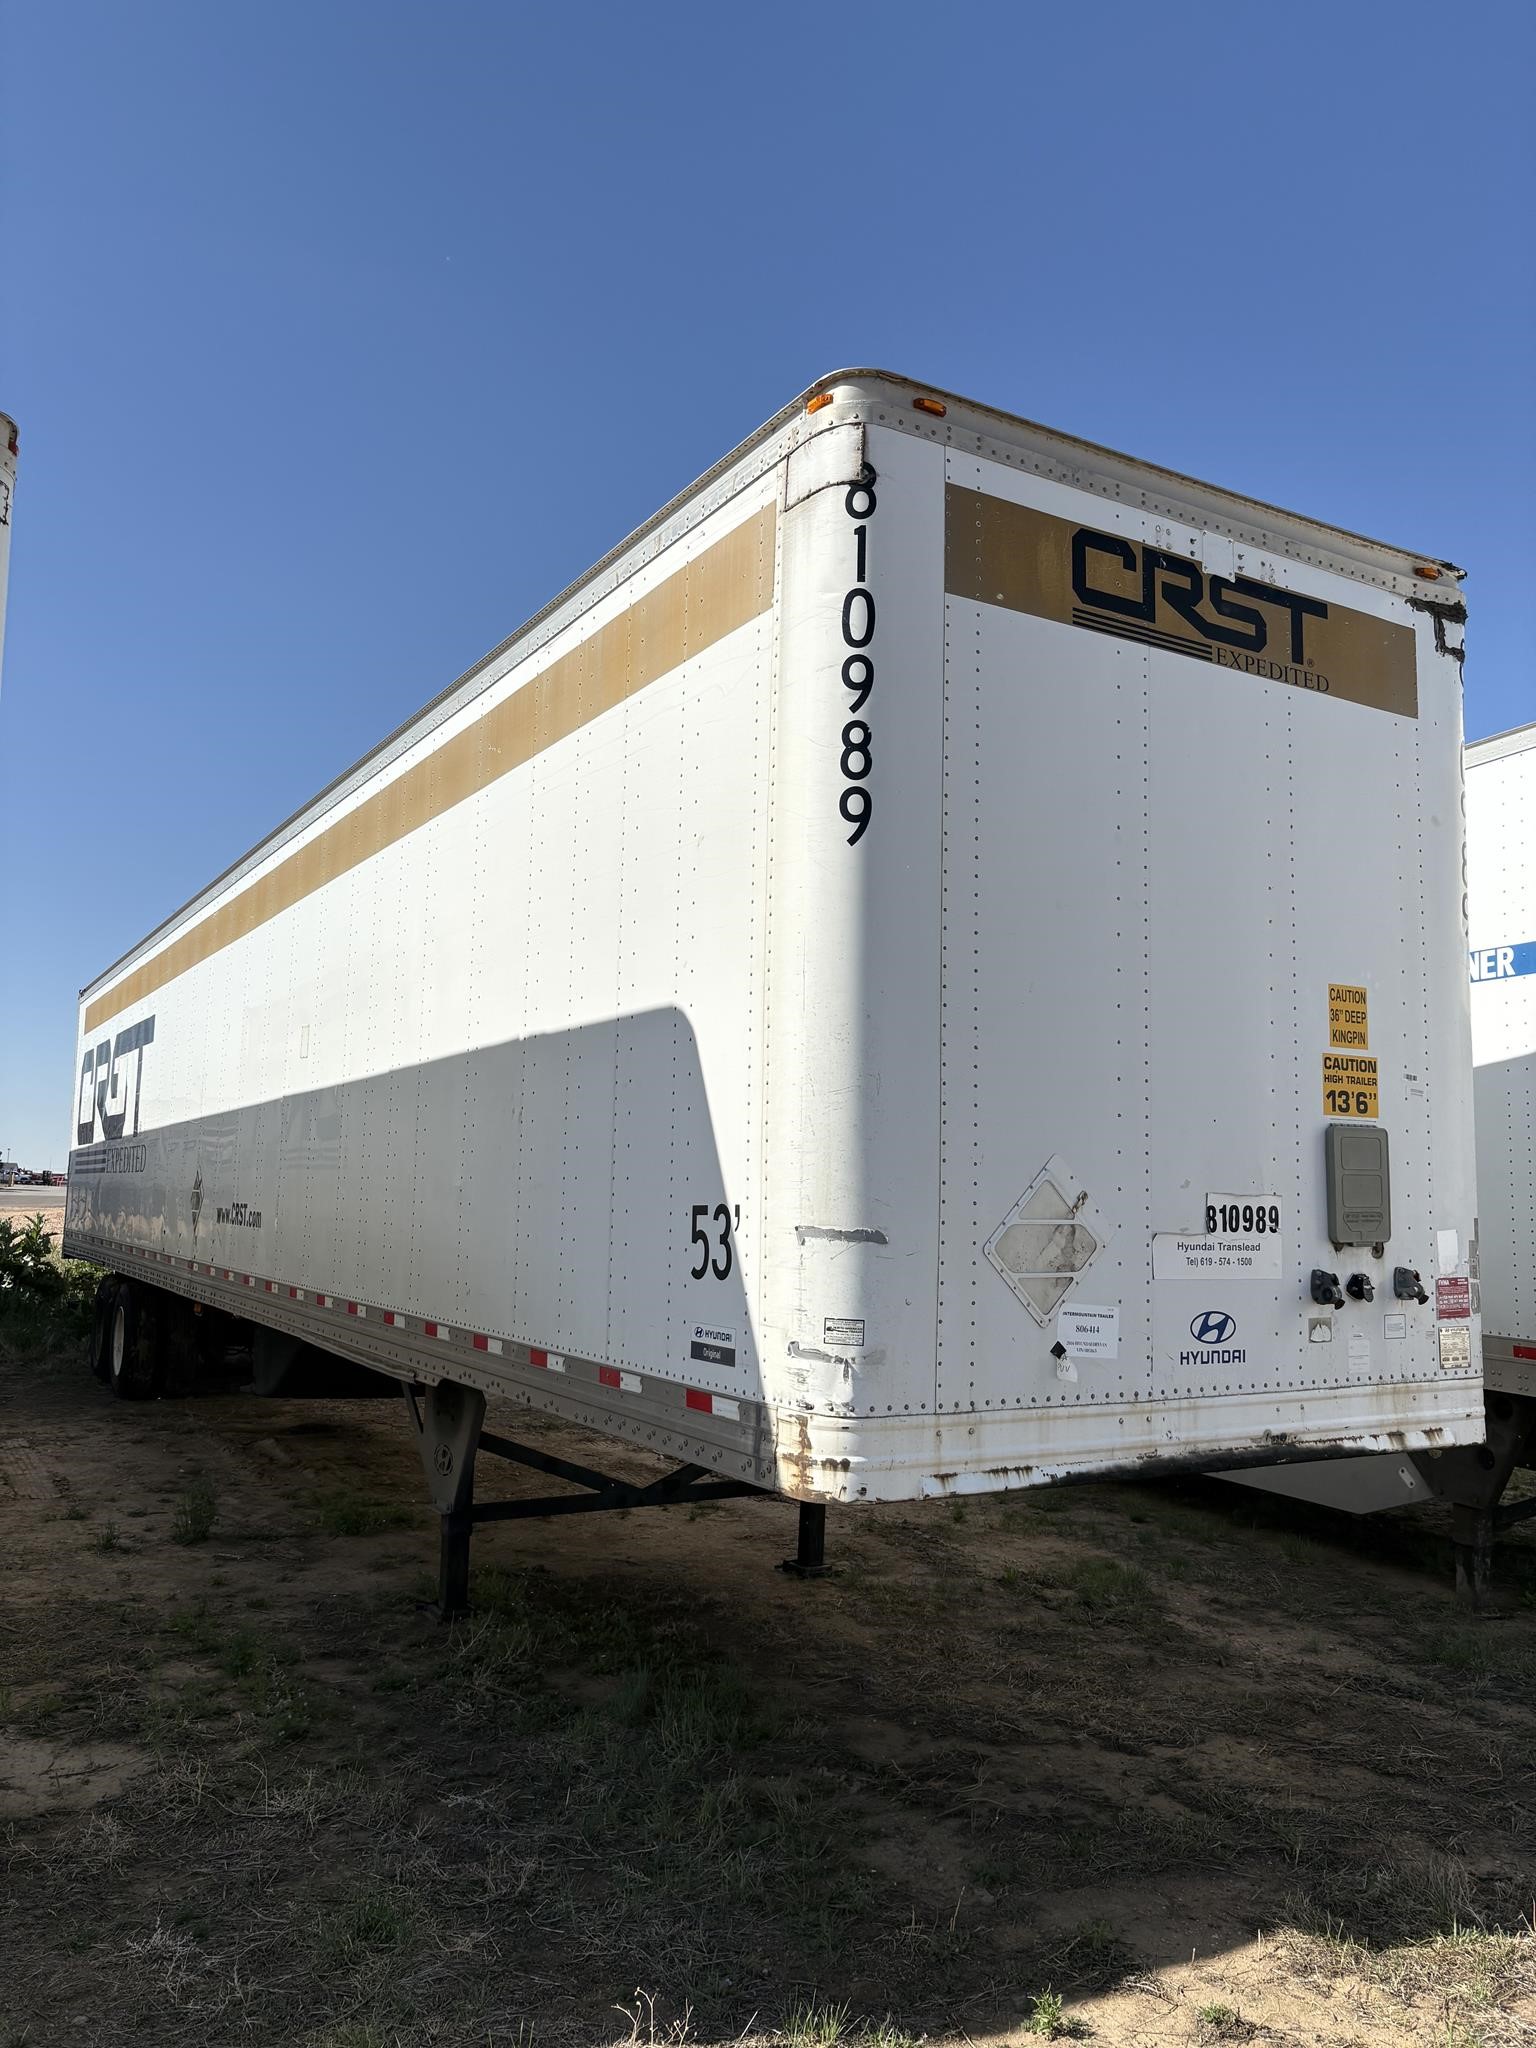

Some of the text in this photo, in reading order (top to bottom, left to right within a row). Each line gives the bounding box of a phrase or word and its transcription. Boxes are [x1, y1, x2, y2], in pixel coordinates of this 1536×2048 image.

[1072, 528, 1328, 665] CRST
[839, 461, 877, 847] 810989
[1216, 647, 1330, 692] EXPEDITED
[1329, 988, 1366, 1004] CAUTION
[1345, 1010, 1367, 1024] DEEP
[1332, 1029, 1366, 1045] KINGPIN
[1324, 1056, 1377, 1073] CAUTION
[77, 1014, 156, 1146] CRST
[1324, 1074, 1378, 1086] HIGH TRAILER
[105, 1144, 147, 1174] EXPEDITED
[216, 1202, 262, 1228] www.CRST.com
[1206, 1204, 1279, 1233] 810989
[691, 1203, 741, 1280] 53'
[1177, 1242, 1261, 1252] Hyundai Translead
[1200, 1257, 1213, 1266] 619
[1218, 1257, 1231, 1266] 574
[1237, 1257, 1253, 1266] 1500
[704, 1329, 733, 1343] HYUNDAI
[1180, 1349, 1246, 1365] HYUNDAI
